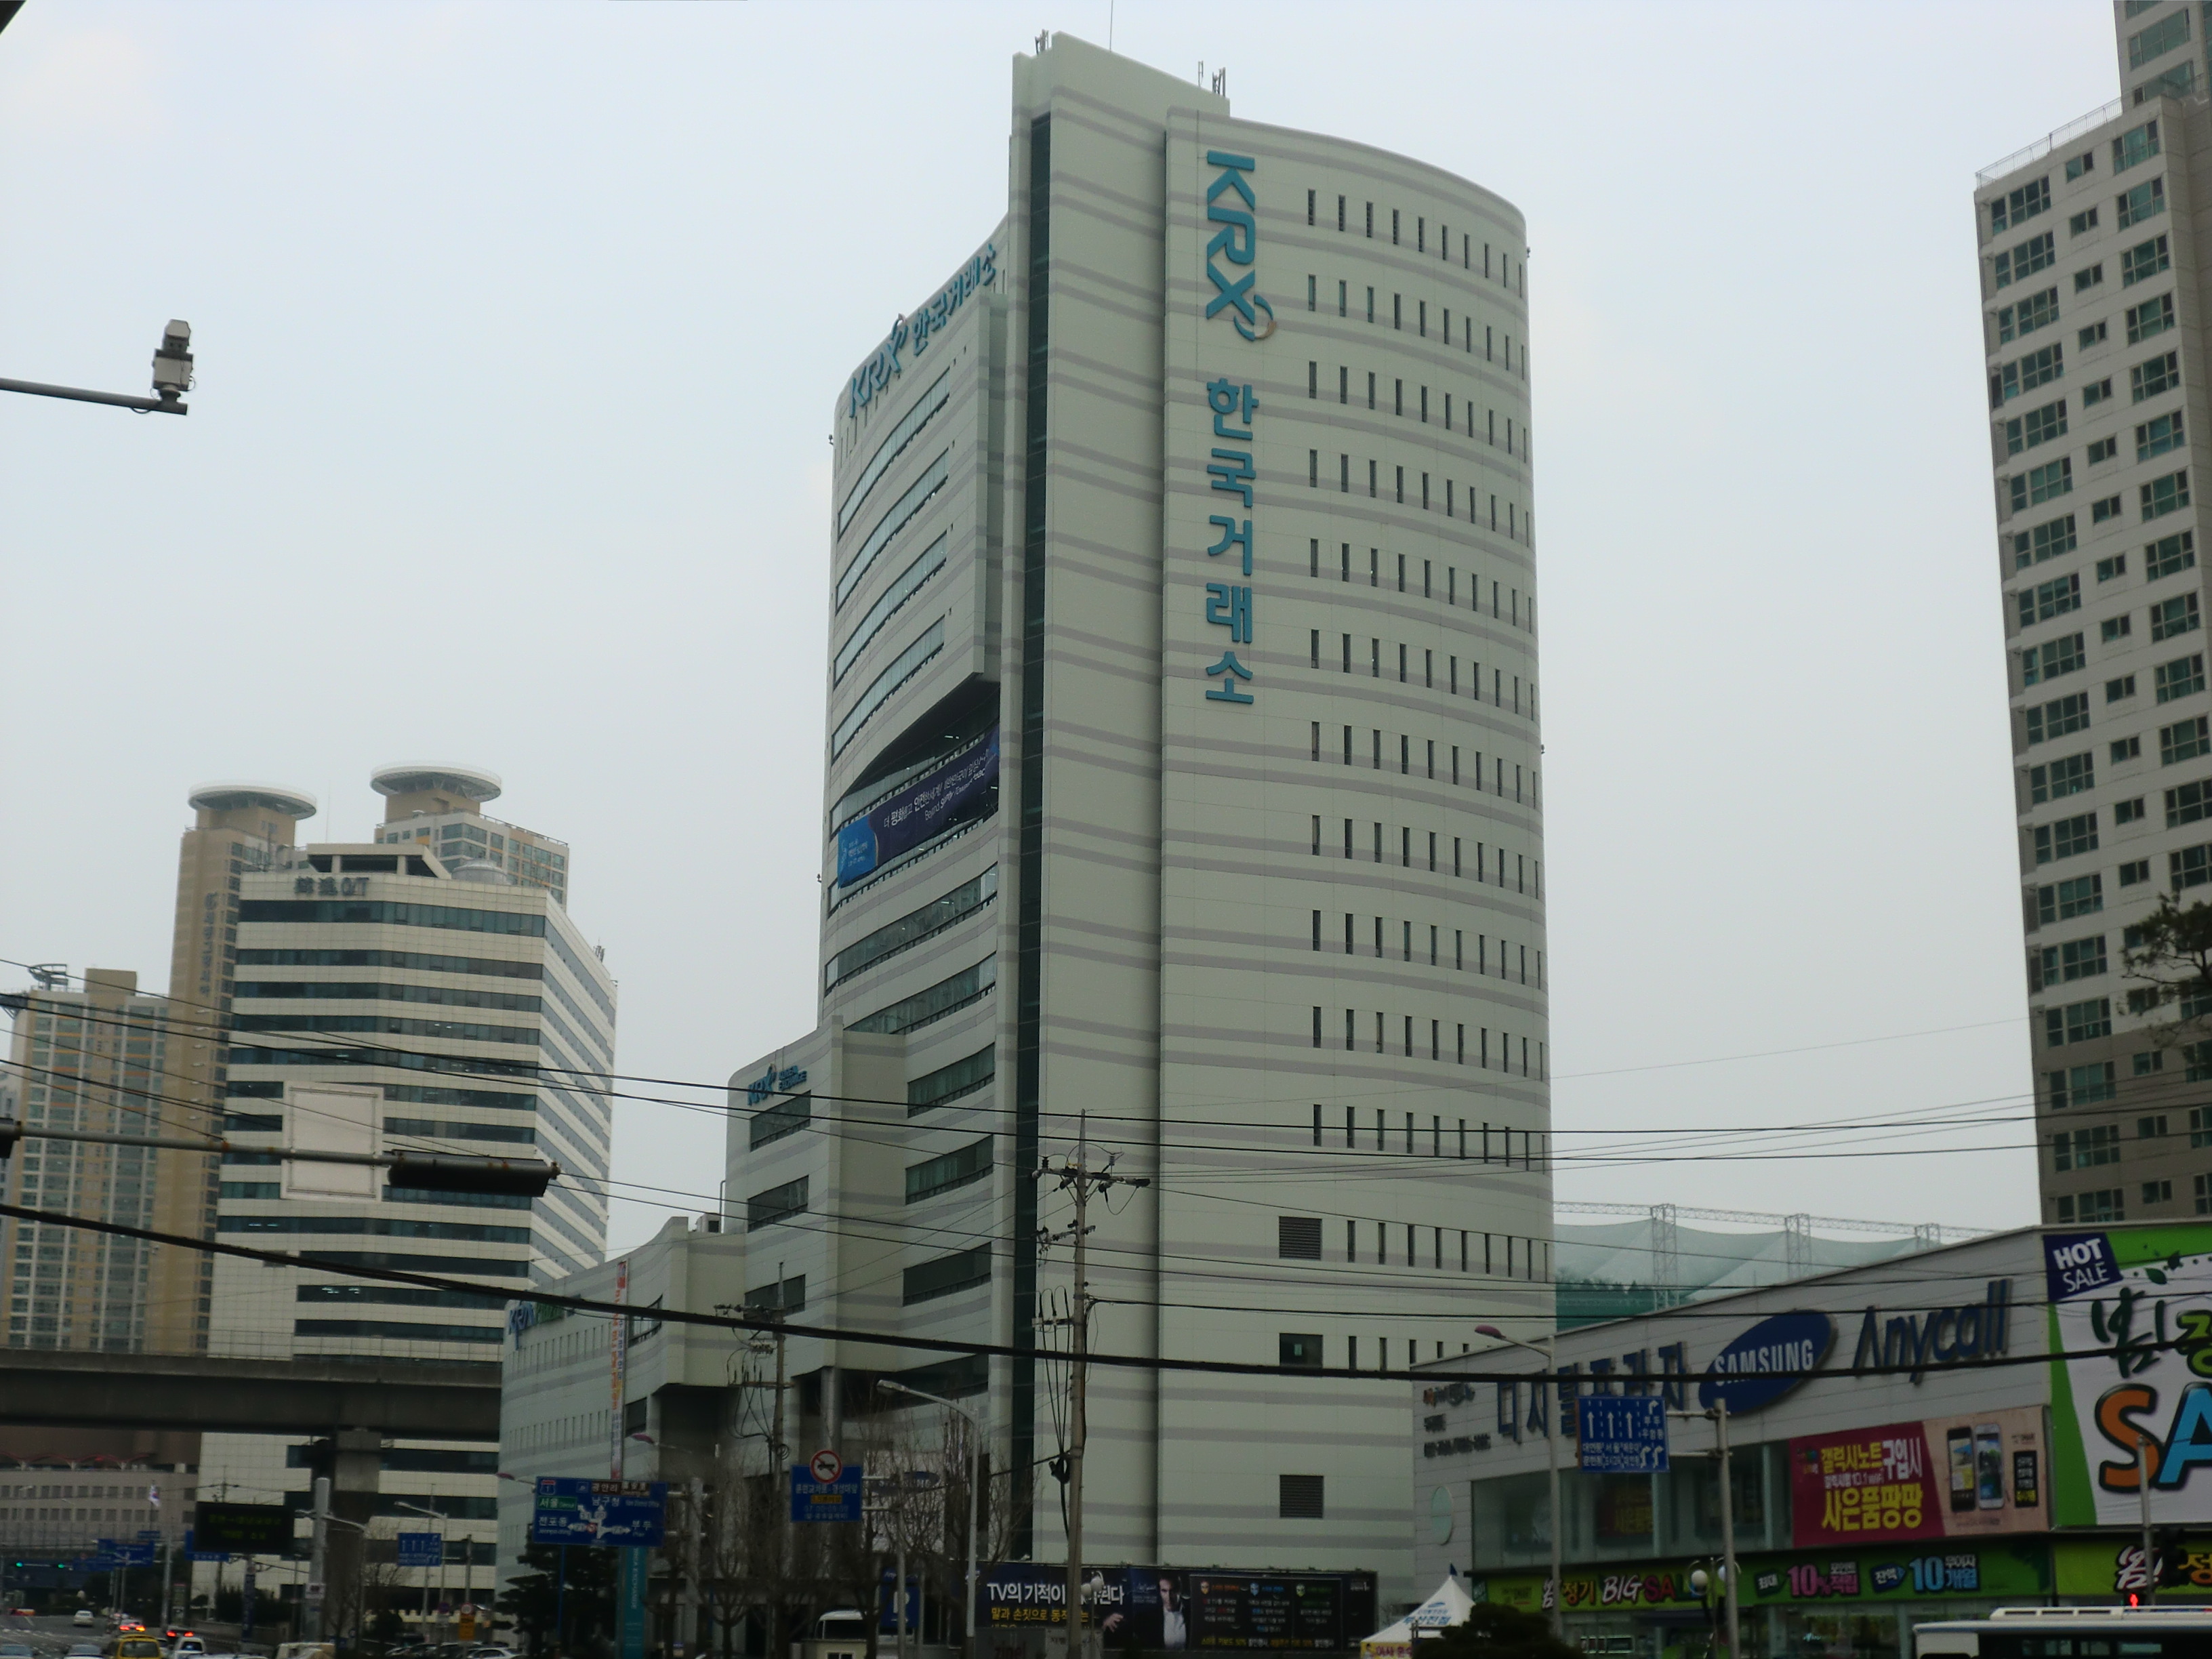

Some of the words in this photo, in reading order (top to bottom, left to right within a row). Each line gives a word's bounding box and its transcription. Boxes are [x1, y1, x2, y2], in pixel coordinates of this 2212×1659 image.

[1206, 150, 1277, 342] KRX
[849, 313, 908, 418] KRX
[912, 243, 996, 357] 한국거래소
[1206, 378, 1259, 704] 한국거래소
[2053, 1237, 2104, 1271] HOT
[2062, 1261, 2110, 1293] SALE
[1853, 1279, 2013, 1383] Anycall
[1714, 1339, 1814, 1387] SAMSUNG
[1602, 1574, 1643, 1605] BIG
[1643, 1574, 1706, 1603] SAL
[1787, 1563, 1830, 1597] 10%
[1909, 1557, 1944, 1592] 10
[987, 1582, 1023, 1604] TV의
[1024, 1582, 1067, 1605] 기적이
[991, 1607, 1010, 1620] 말과
